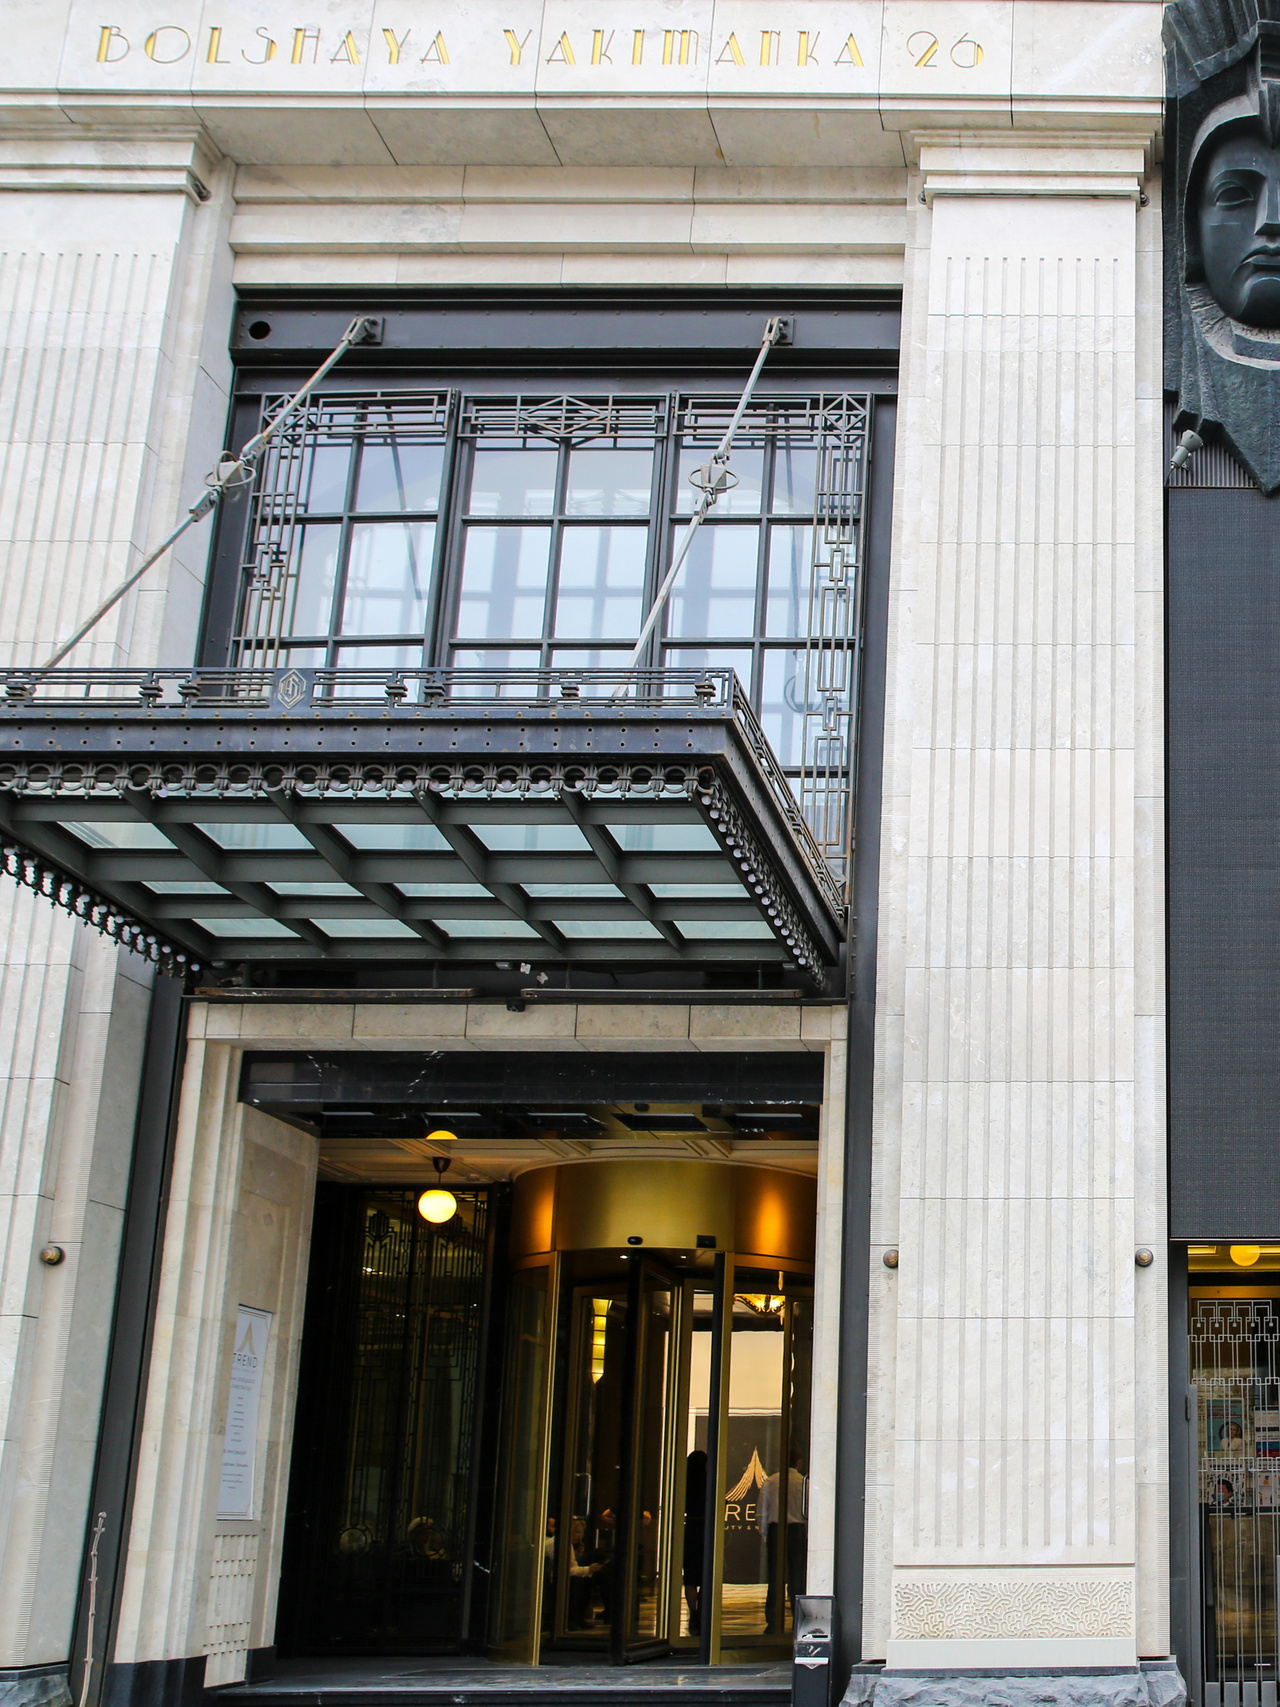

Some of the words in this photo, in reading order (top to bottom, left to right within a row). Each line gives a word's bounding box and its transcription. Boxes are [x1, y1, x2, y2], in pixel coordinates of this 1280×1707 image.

[97, 25, 451, 66] BOLSHAYA
[502, 28, 865, 68] YAKIMANKA
[906, 30, 985, 69] 26
